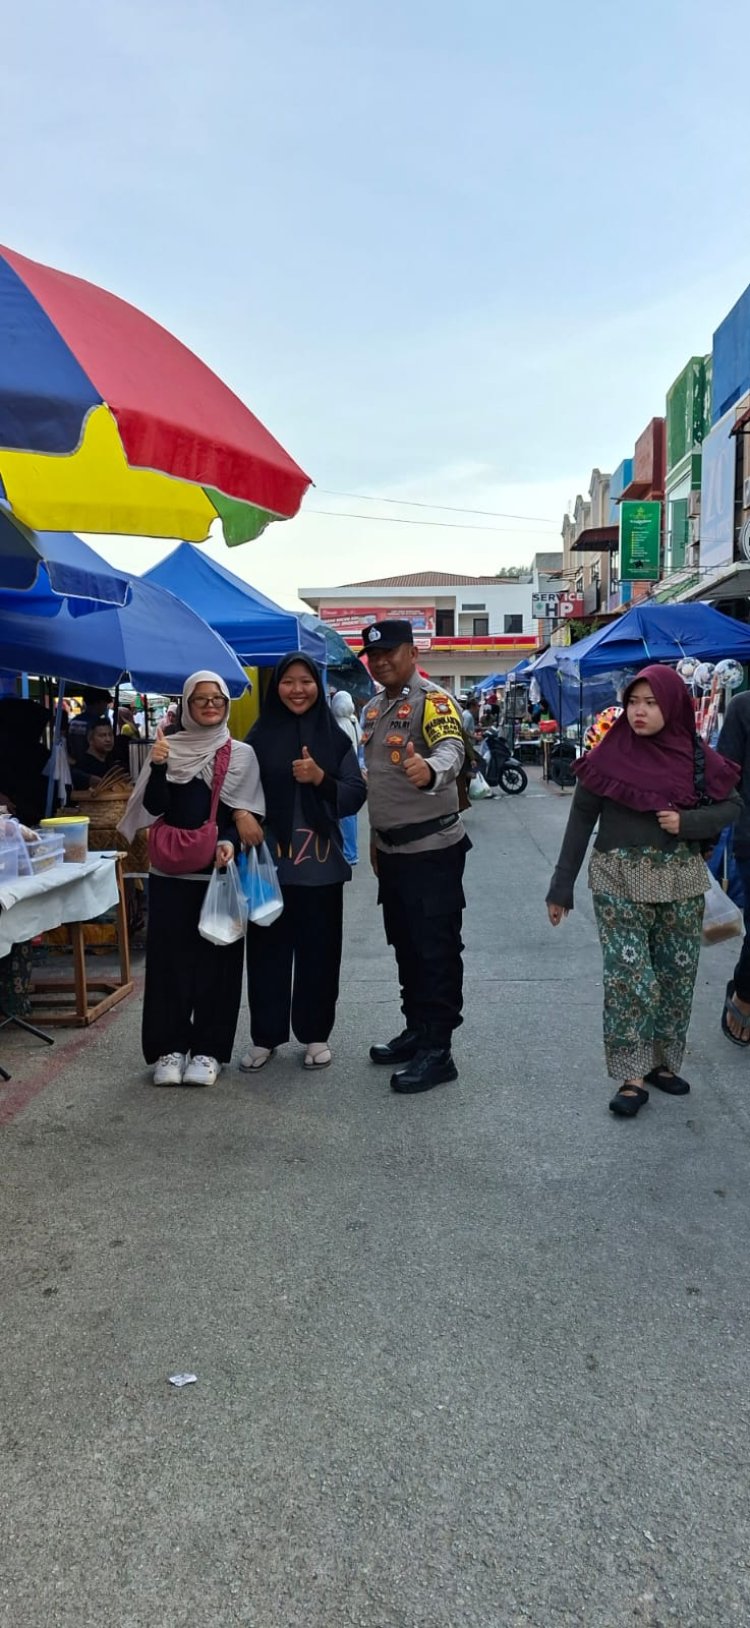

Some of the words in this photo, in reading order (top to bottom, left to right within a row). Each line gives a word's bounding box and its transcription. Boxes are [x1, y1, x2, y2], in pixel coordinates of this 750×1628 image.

[532, 593, 583, 601] SERVICE
[545, 602, 574, 617] HP
[390, 720, 410, 729] POLRI
